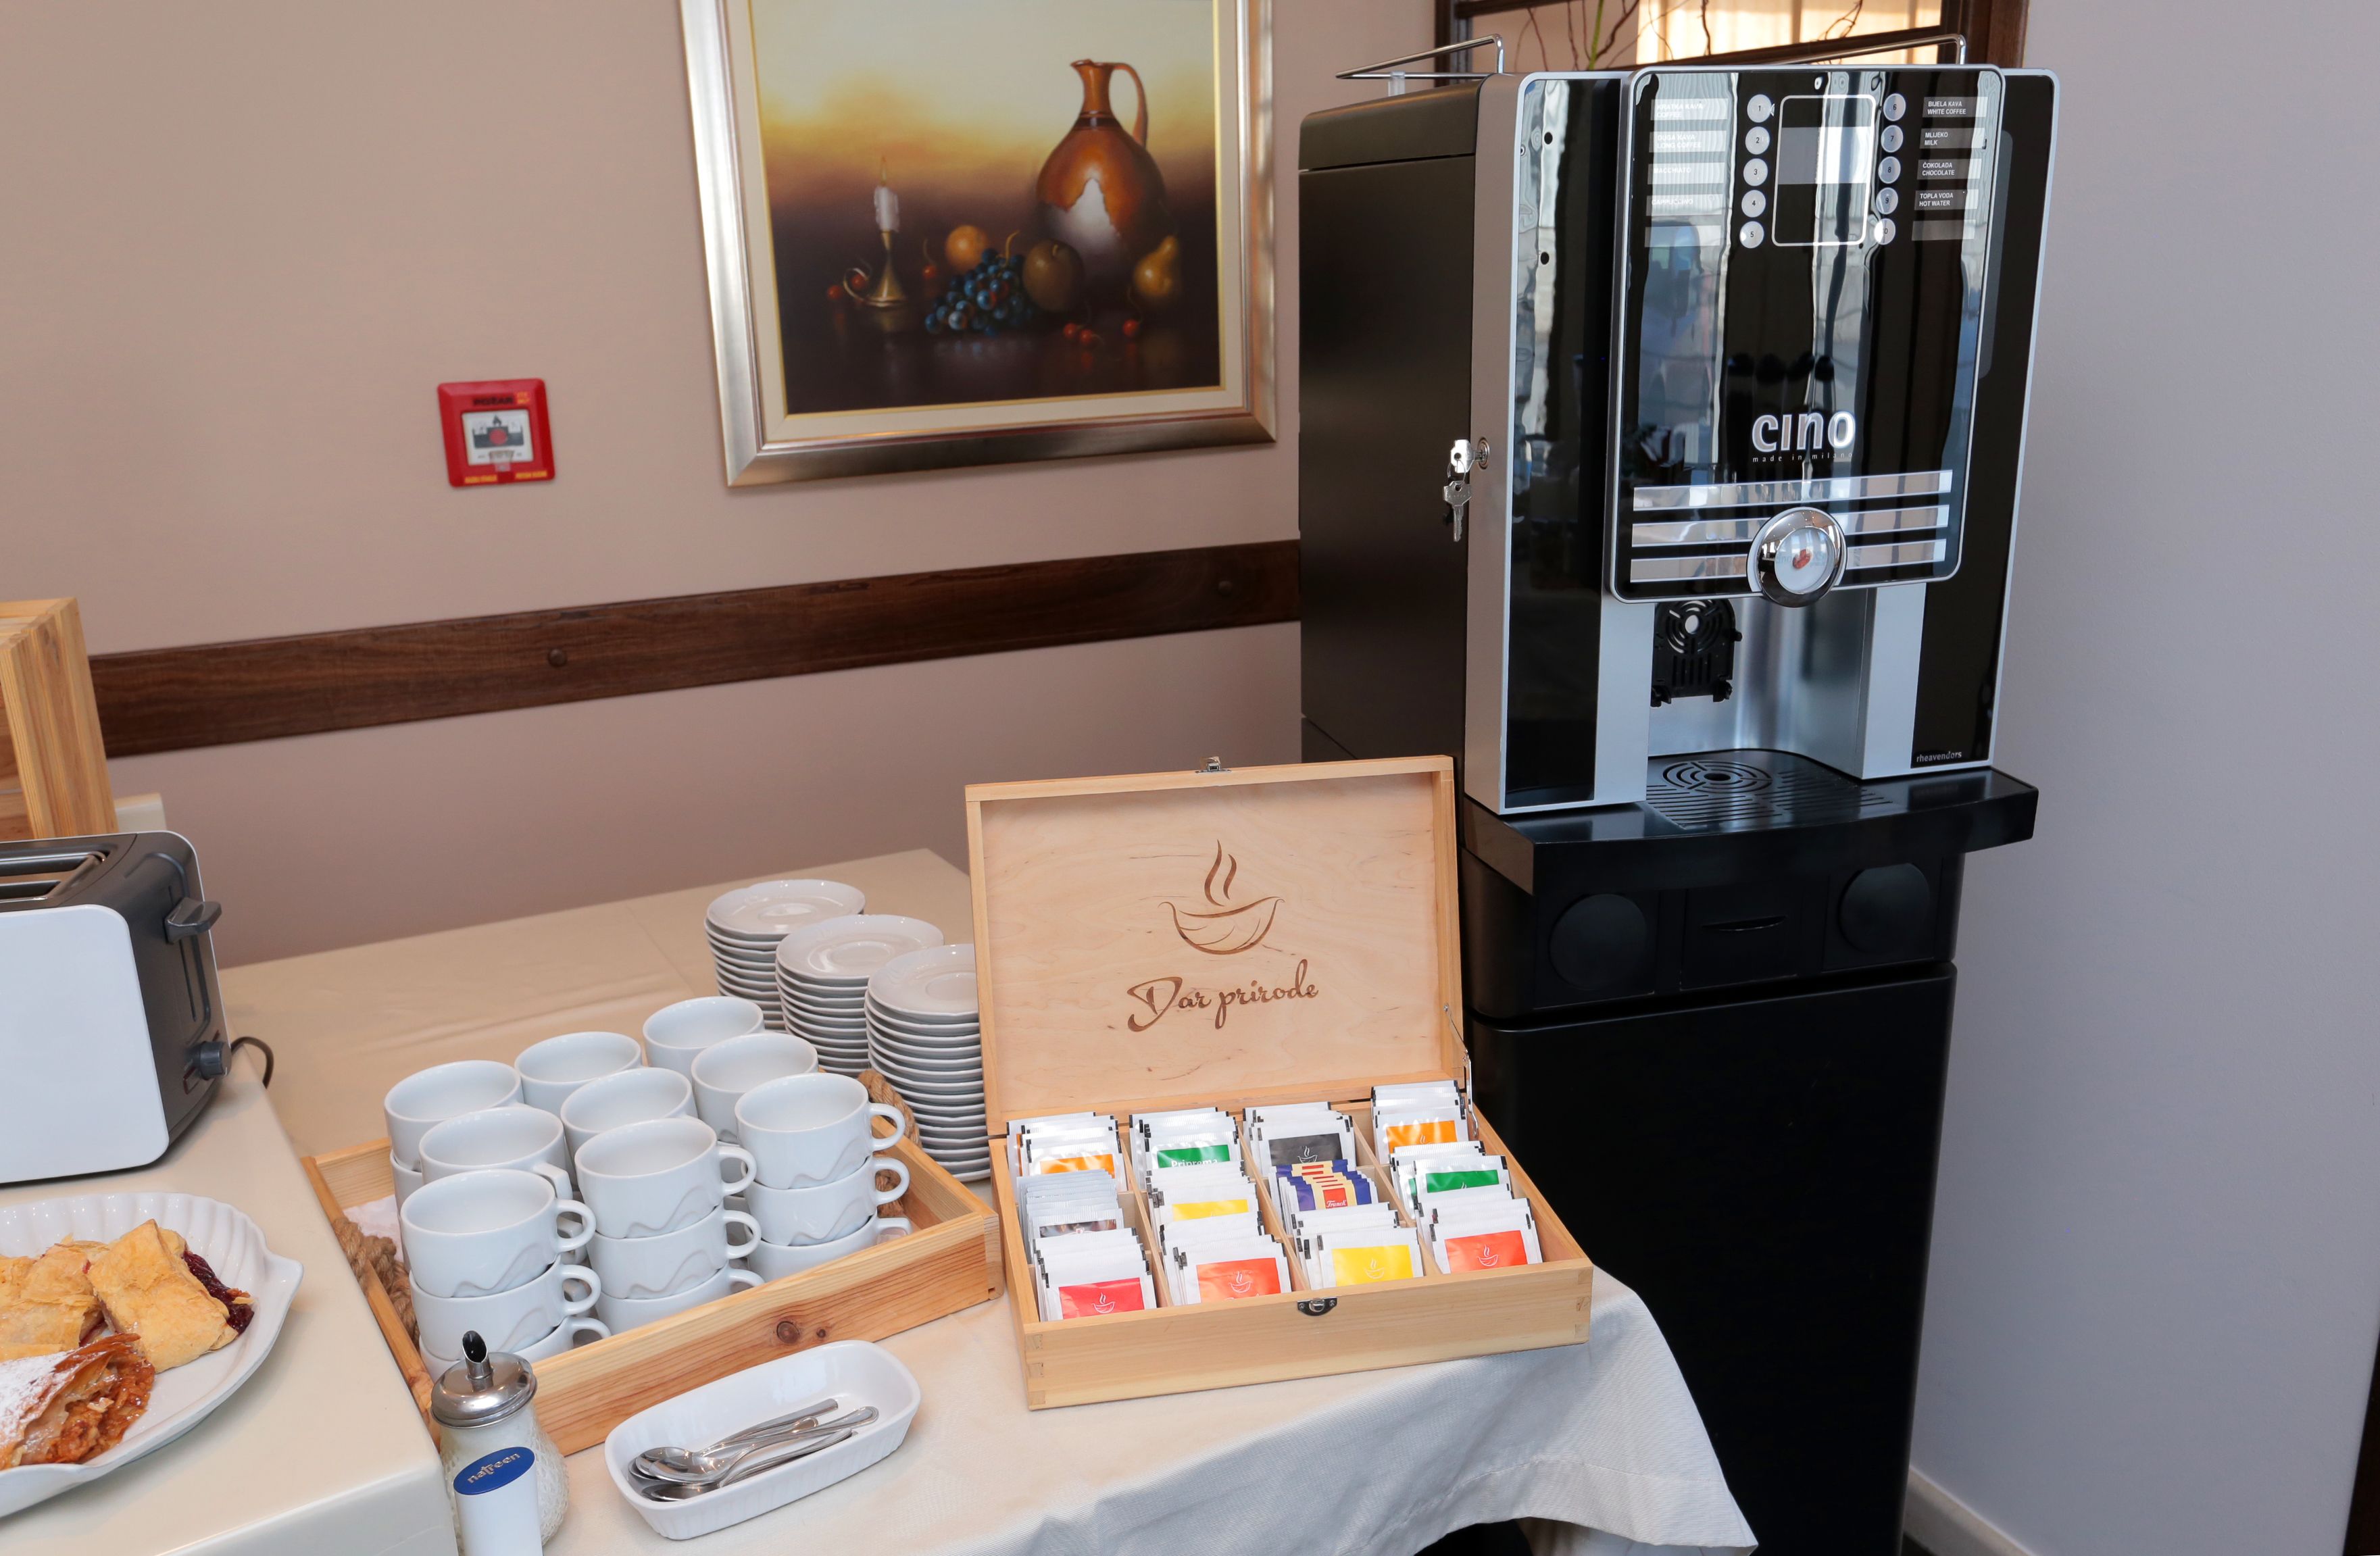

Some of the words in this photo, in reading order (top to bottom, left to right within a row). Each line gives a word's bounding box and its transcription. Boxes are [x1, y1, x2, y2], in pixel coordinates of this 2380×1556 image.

[1752, 411, 1856, 453] cino
[1752, 455, 1783, 463] made
[1916, 751, 1962, 763] rheavendors
[1126, 976, 1212, 1032] Dar
[1215, 959, 1319, 1030] prirode
[1326, 1199, 1347, 1208] Franck
[467, 1453, 520, 1484] natreen
